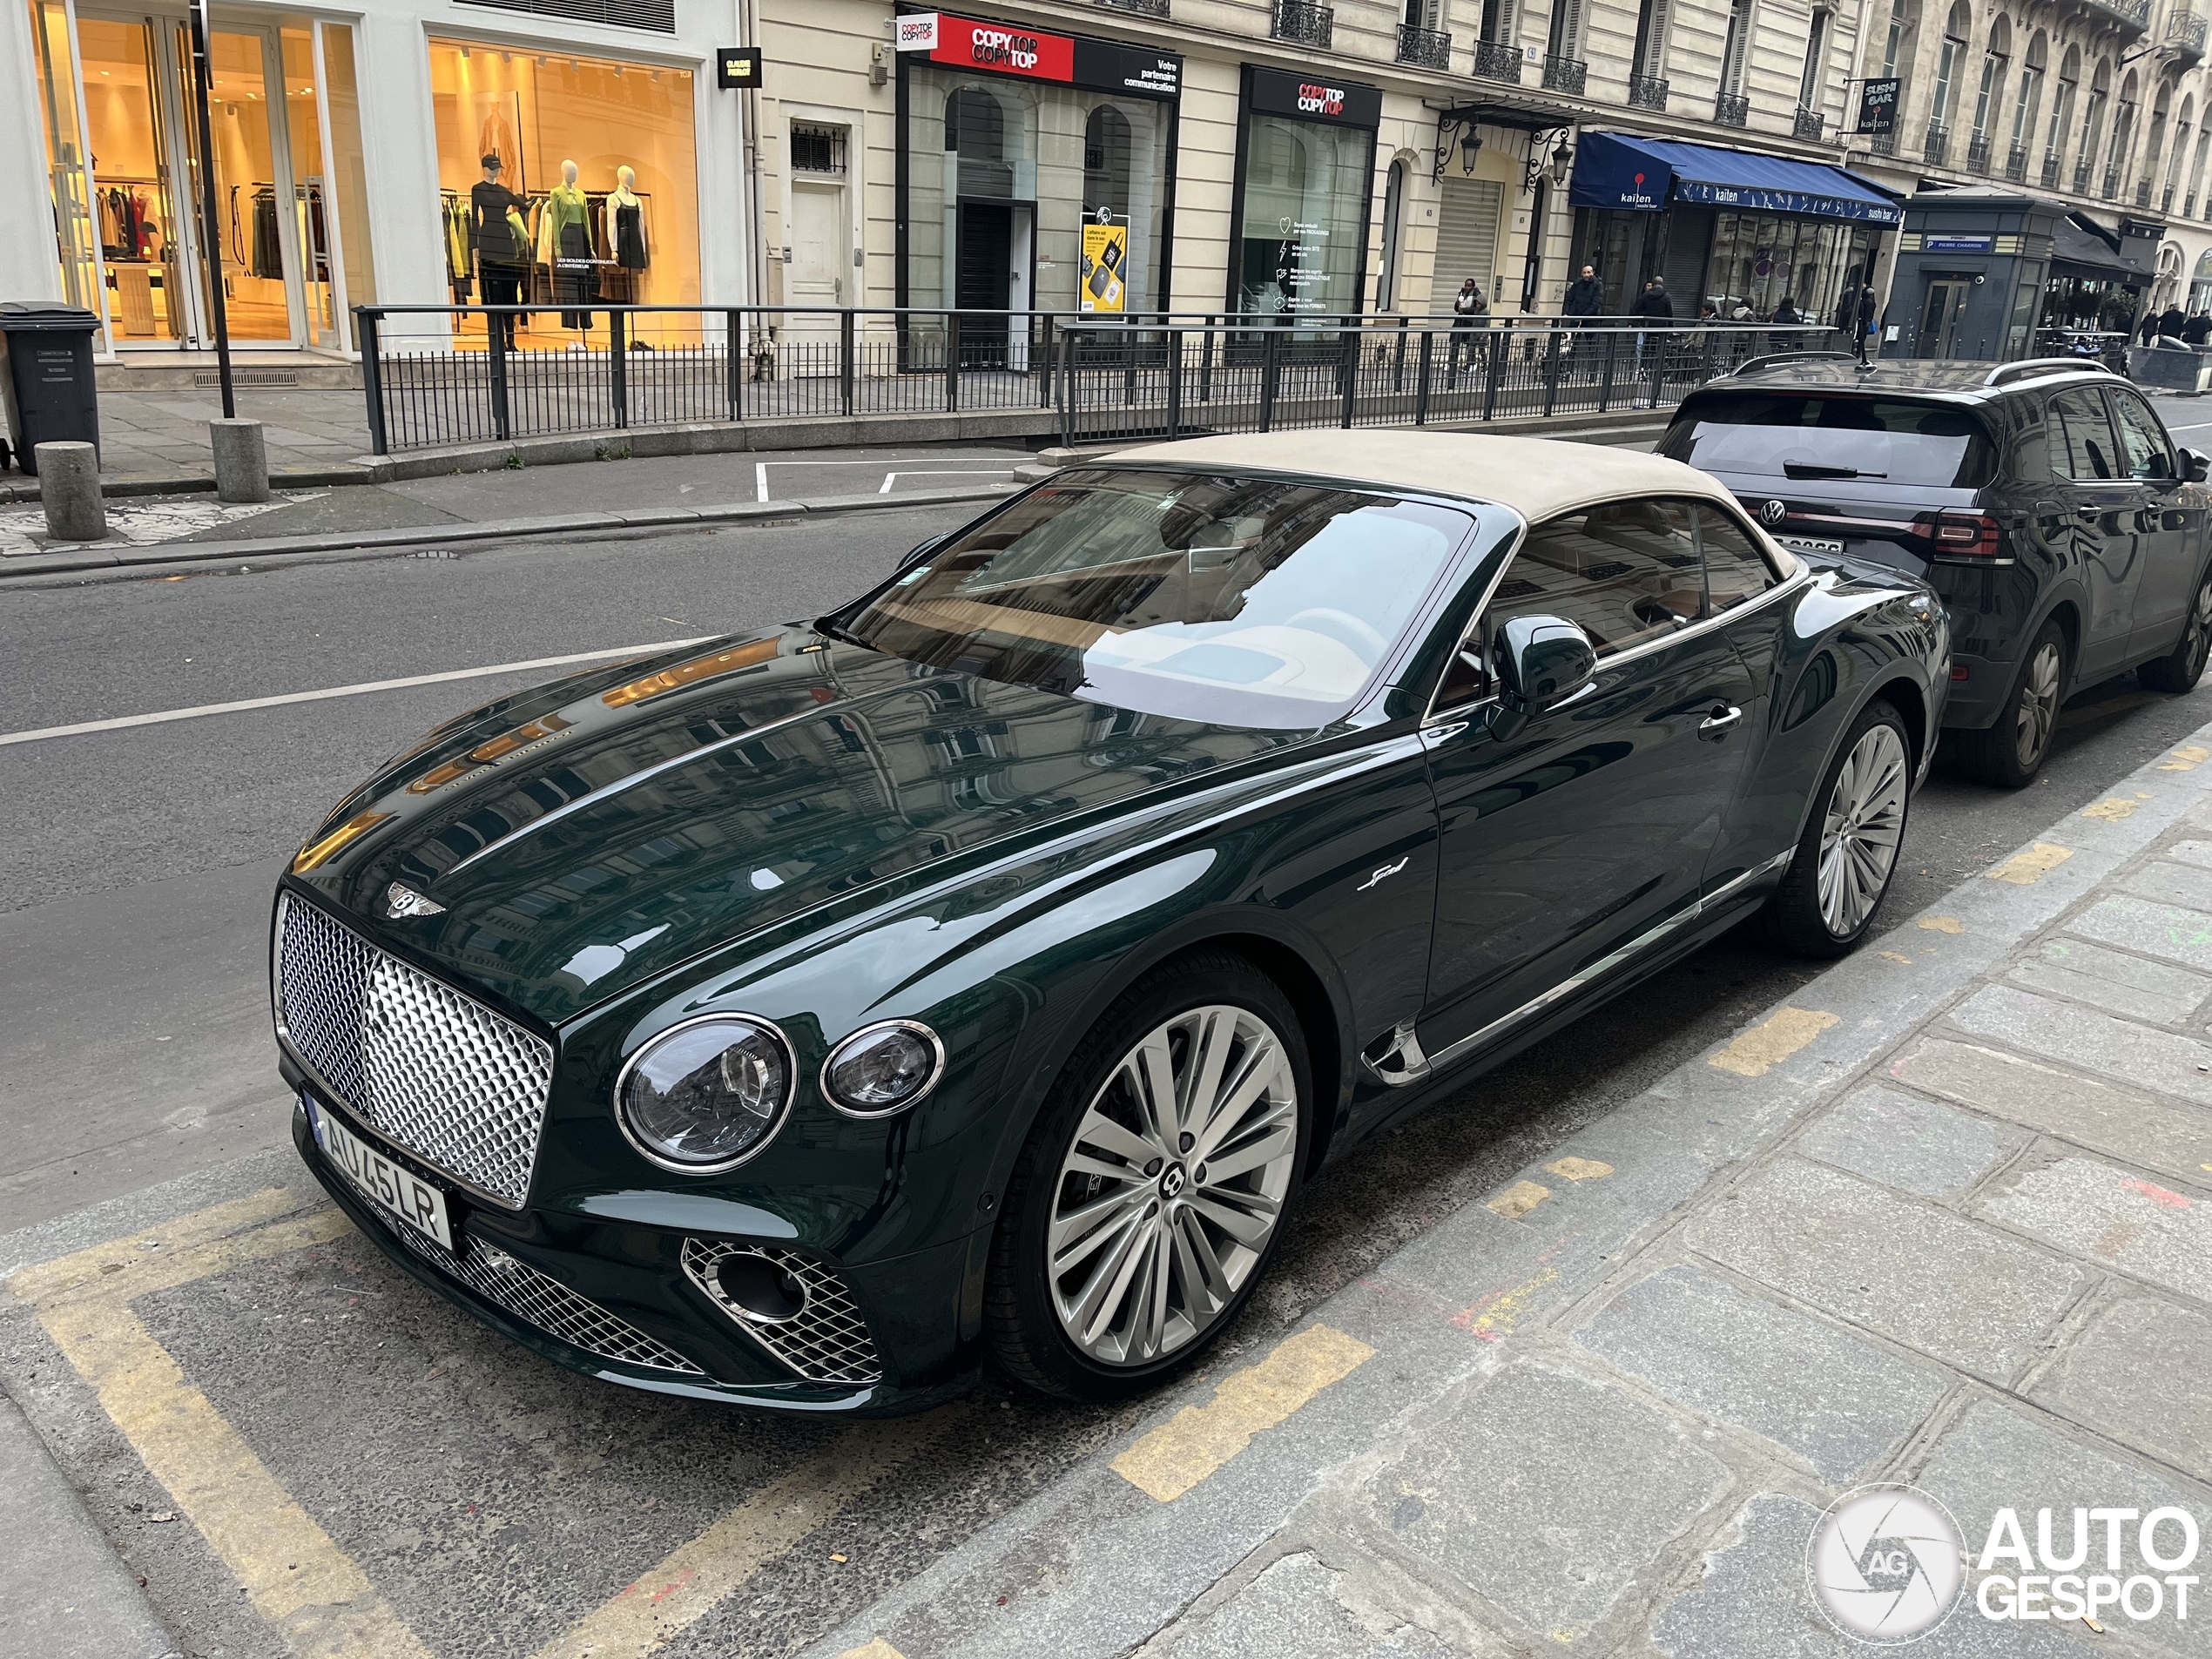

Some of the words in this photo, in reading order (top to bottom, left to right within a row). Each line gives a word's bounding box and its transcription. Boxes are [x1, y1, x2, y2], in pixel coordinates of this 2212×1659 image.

[902, 23, 932, 32] COPYTOP
[902, 31, 932, 40] COPYTOP
[972, 29, 1038, 51] COPYTOP
[972, 44, 1038, 69] COPYTOP
[1157, 59, 1177, 71] Votre
[1141, 70, 1177, 82] partenaire
[1124, 78, 1176, 92] communication
[1865, 82, 1897, 96] SUSHI
[1298, 84, 1345, 103] COPYTOP
[1868, 93, 1893, 105] BAR
[1298, 97, 1344, 115] COPYTOP
[1868, 207, 1883, 219] sushi
[1883, 208, 1892, 219] bar
